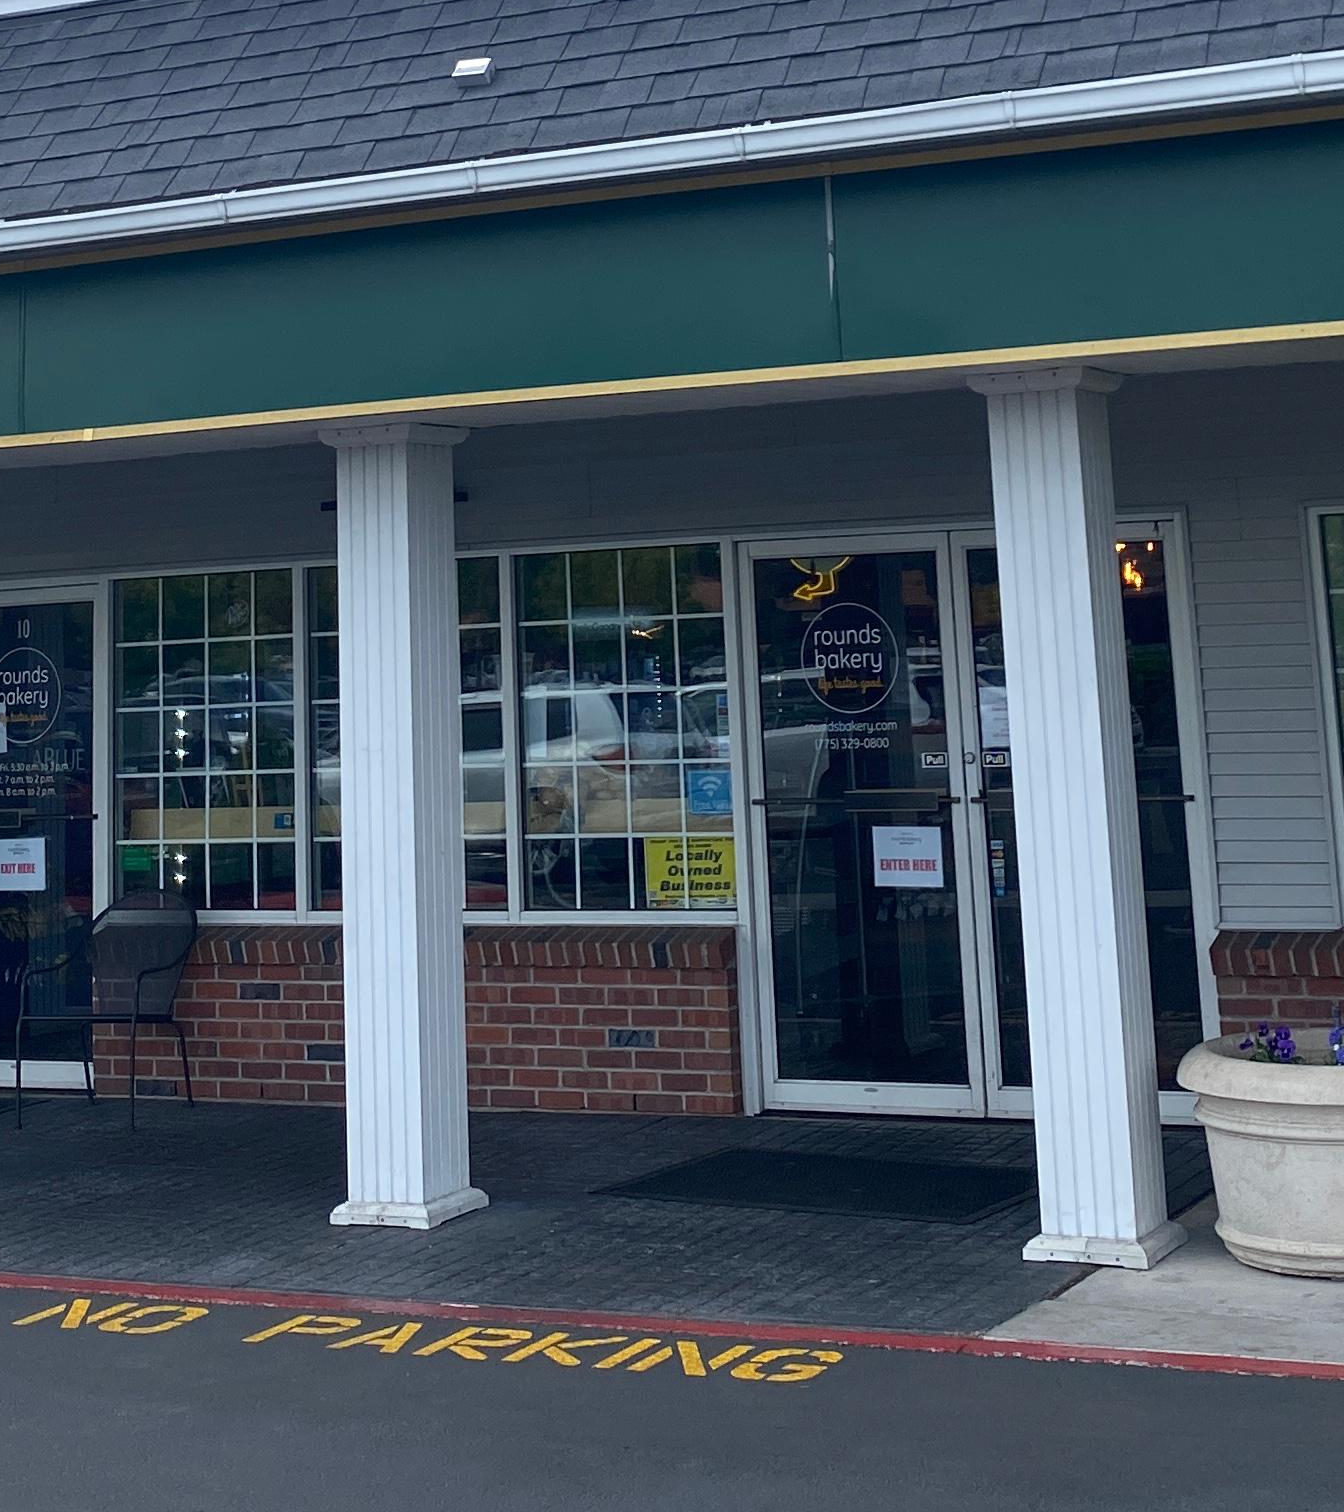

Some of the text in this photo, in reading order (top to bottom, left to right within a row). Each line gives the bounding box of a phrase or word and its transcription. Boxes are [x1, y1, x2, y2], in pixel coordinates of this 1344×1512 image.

[17, 618, 31, 639] 10
[814, 623, 882, 647] rounds
[814, 648, 883, 673] bakery
[803, 719, 898, 734] rodsbakery.com
[841, 737, 890, 750] 329-0800
[926, 755, 945, 765] Pull
[985, 754, 1005, 764] Pull
[665, 849, 723, 863] Locally
[668, 864, 723, 876] Owned
[880, 858, 938, 872] ENTER HERE
[660, 880, 731, 892] Buiness
[12, 1298, 843, 1383] NO PARKING
